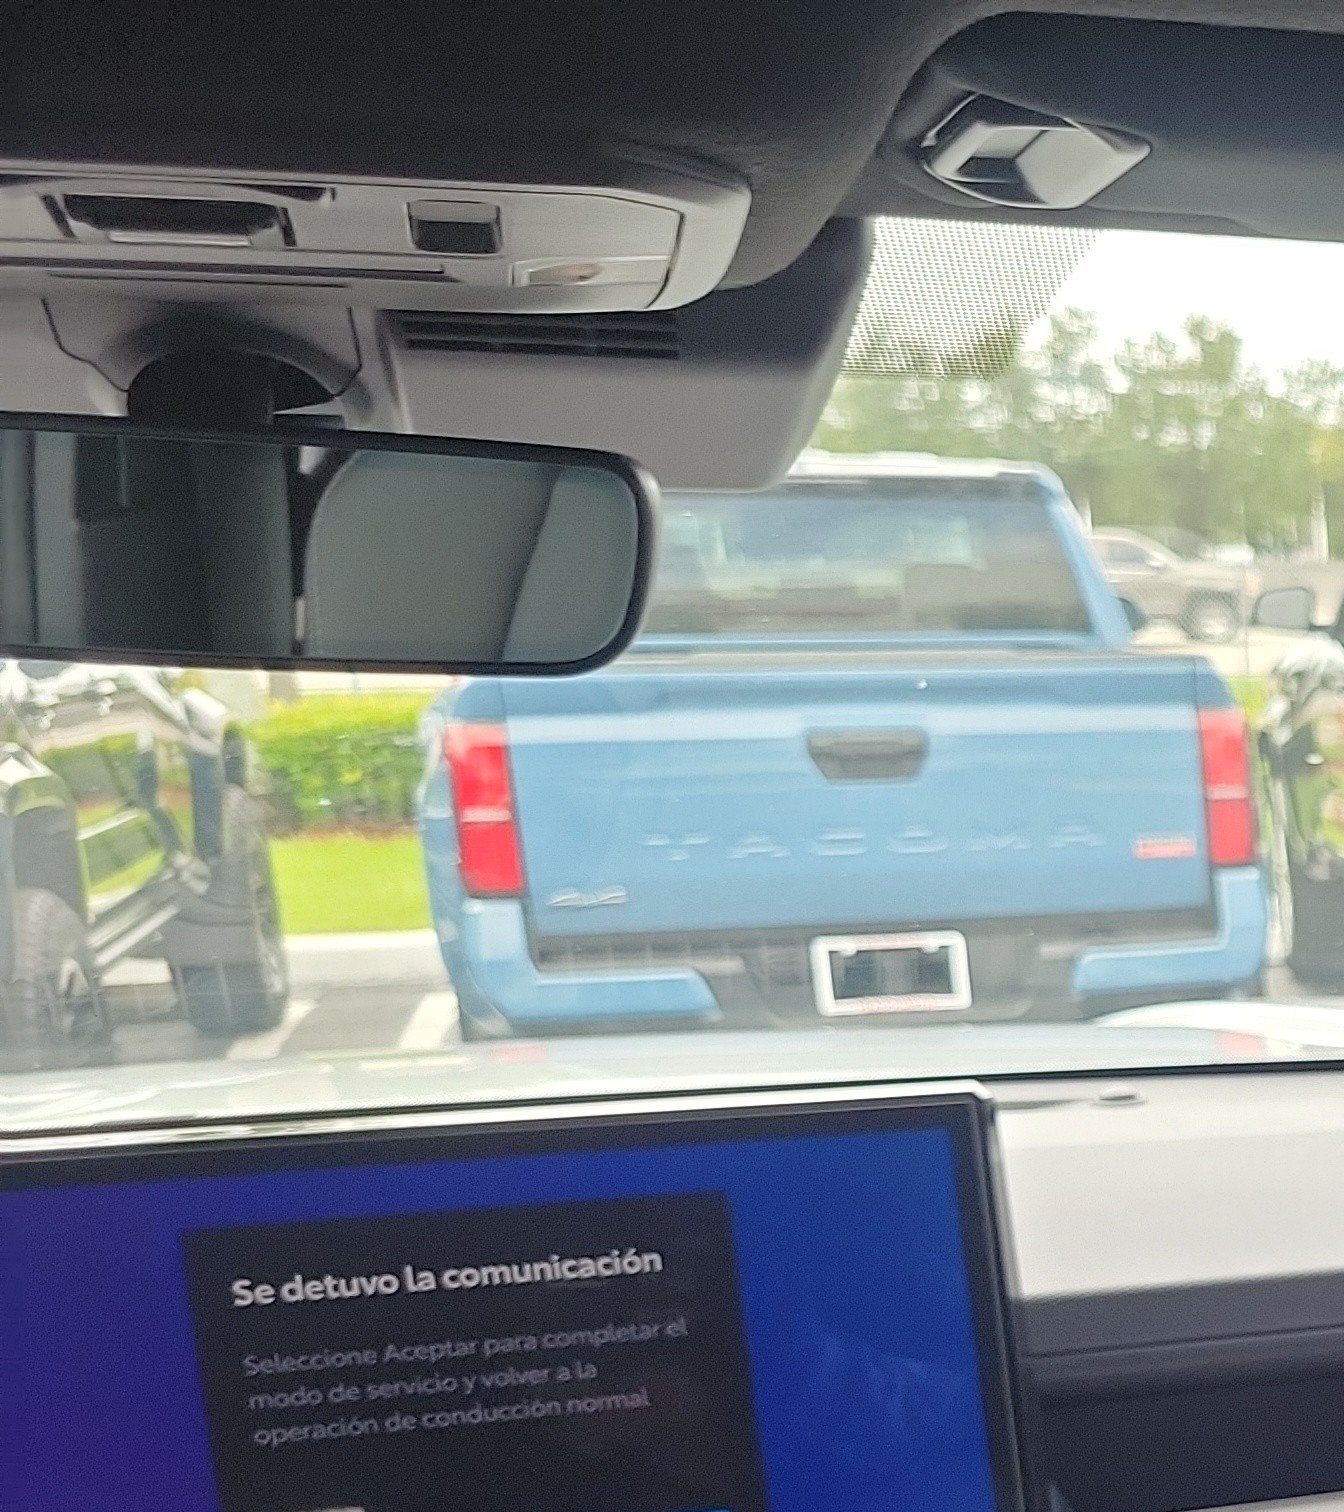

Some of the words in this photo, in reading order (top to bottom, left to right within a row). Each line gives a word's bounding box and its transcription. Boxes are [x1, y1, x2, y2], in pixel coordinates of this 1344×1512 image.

[642, 823, 1104, 861] TACOMA
[231, 1277, 276, 1307] Se
[280, 1270, 399, 1304] detuvo
[405, 1264, 437, 1293] la
[441, 1248, 664, 1288] comunicación
[244, 1347, 378, 1377] Seleccione
[383, 1339, 478, 1366] Aceptar
[483, 1334, 538, 1359] para
[542, 1322, 660, 1351] completar
[666, 1317, 688, 1338] el
[249, 1385, 323, 1411] modo
[328, 1379, 361, 1403] de
[367, 1371, 458, 1399] servicio
[462, 1374, 477, 1395] y
[480, 1365, 550, 1389] volver
[556, 1365, 571, 1382] a
[574, 1359, 599, 1380] la
[254, 1415, 379, 1449] operación
[384, 1410, 417, 1432] de
[422, 1398, 561, 1428] conducción
[566, 1386, 650, 1415] normal
